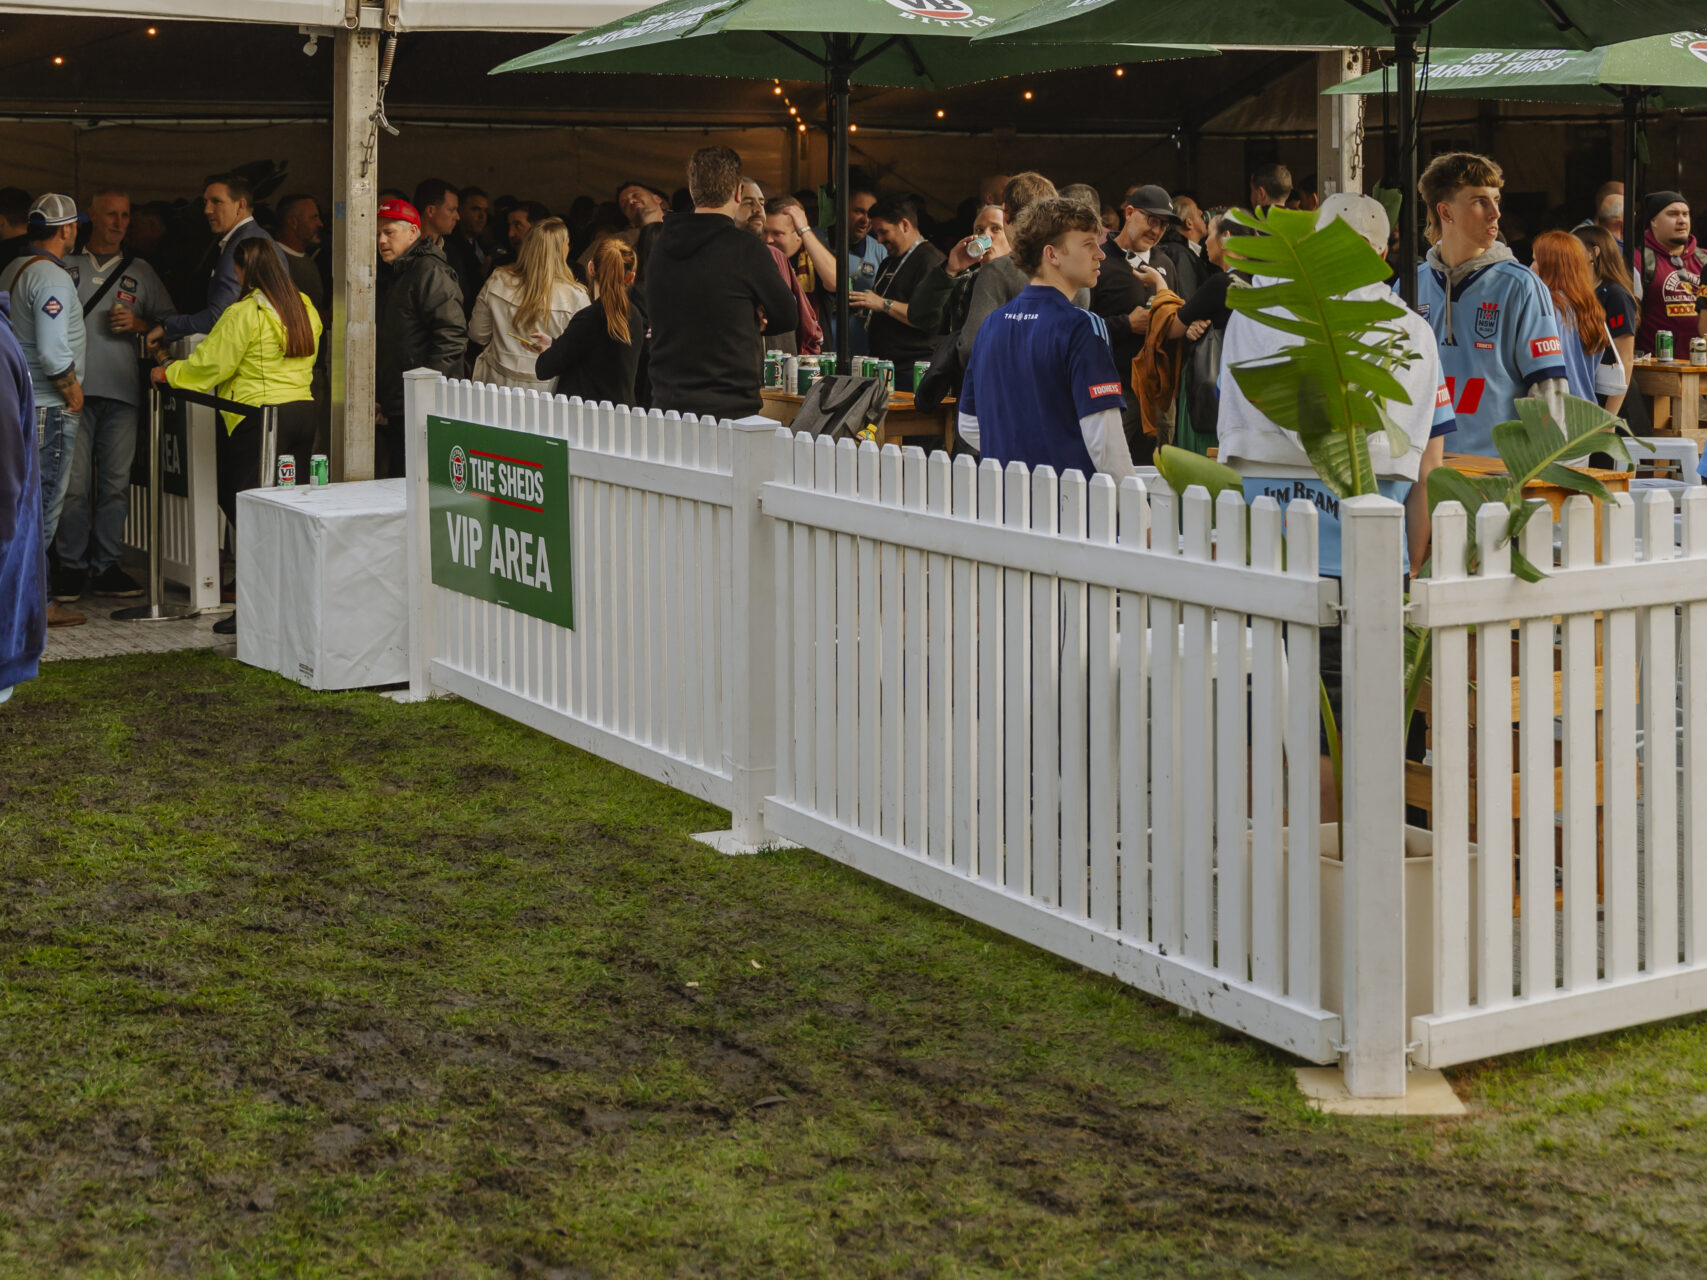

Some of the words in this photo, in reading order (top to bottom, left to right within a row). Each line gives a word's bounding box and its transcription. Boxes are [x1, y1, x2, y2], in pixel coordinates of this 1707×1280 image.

[898, 11, 996, 29] BITTER
[1461, 52, 1503, 64] FOR
[1498, 52, 1518, 62] A
[1512, 49, 1568, 62] HARD
[1415, 64, 1500, 78] EARNED
[1494, 57, 1577, 75] THIRST
[1023, 313, 1039, 321] STAR
[1478, 320, 1495, 328] NSW
[1092, 383, 1119, 396] TOOHEYS
[280, 468, 294, 477] VB
[469, 457, 496, 494] THE
[498, 463, 544, 505] SHEDS
[1293, 481, 1340, 521] BEAM
[446, 511, 483, 569] VIP
[489, 524, 553, 593] AREA
